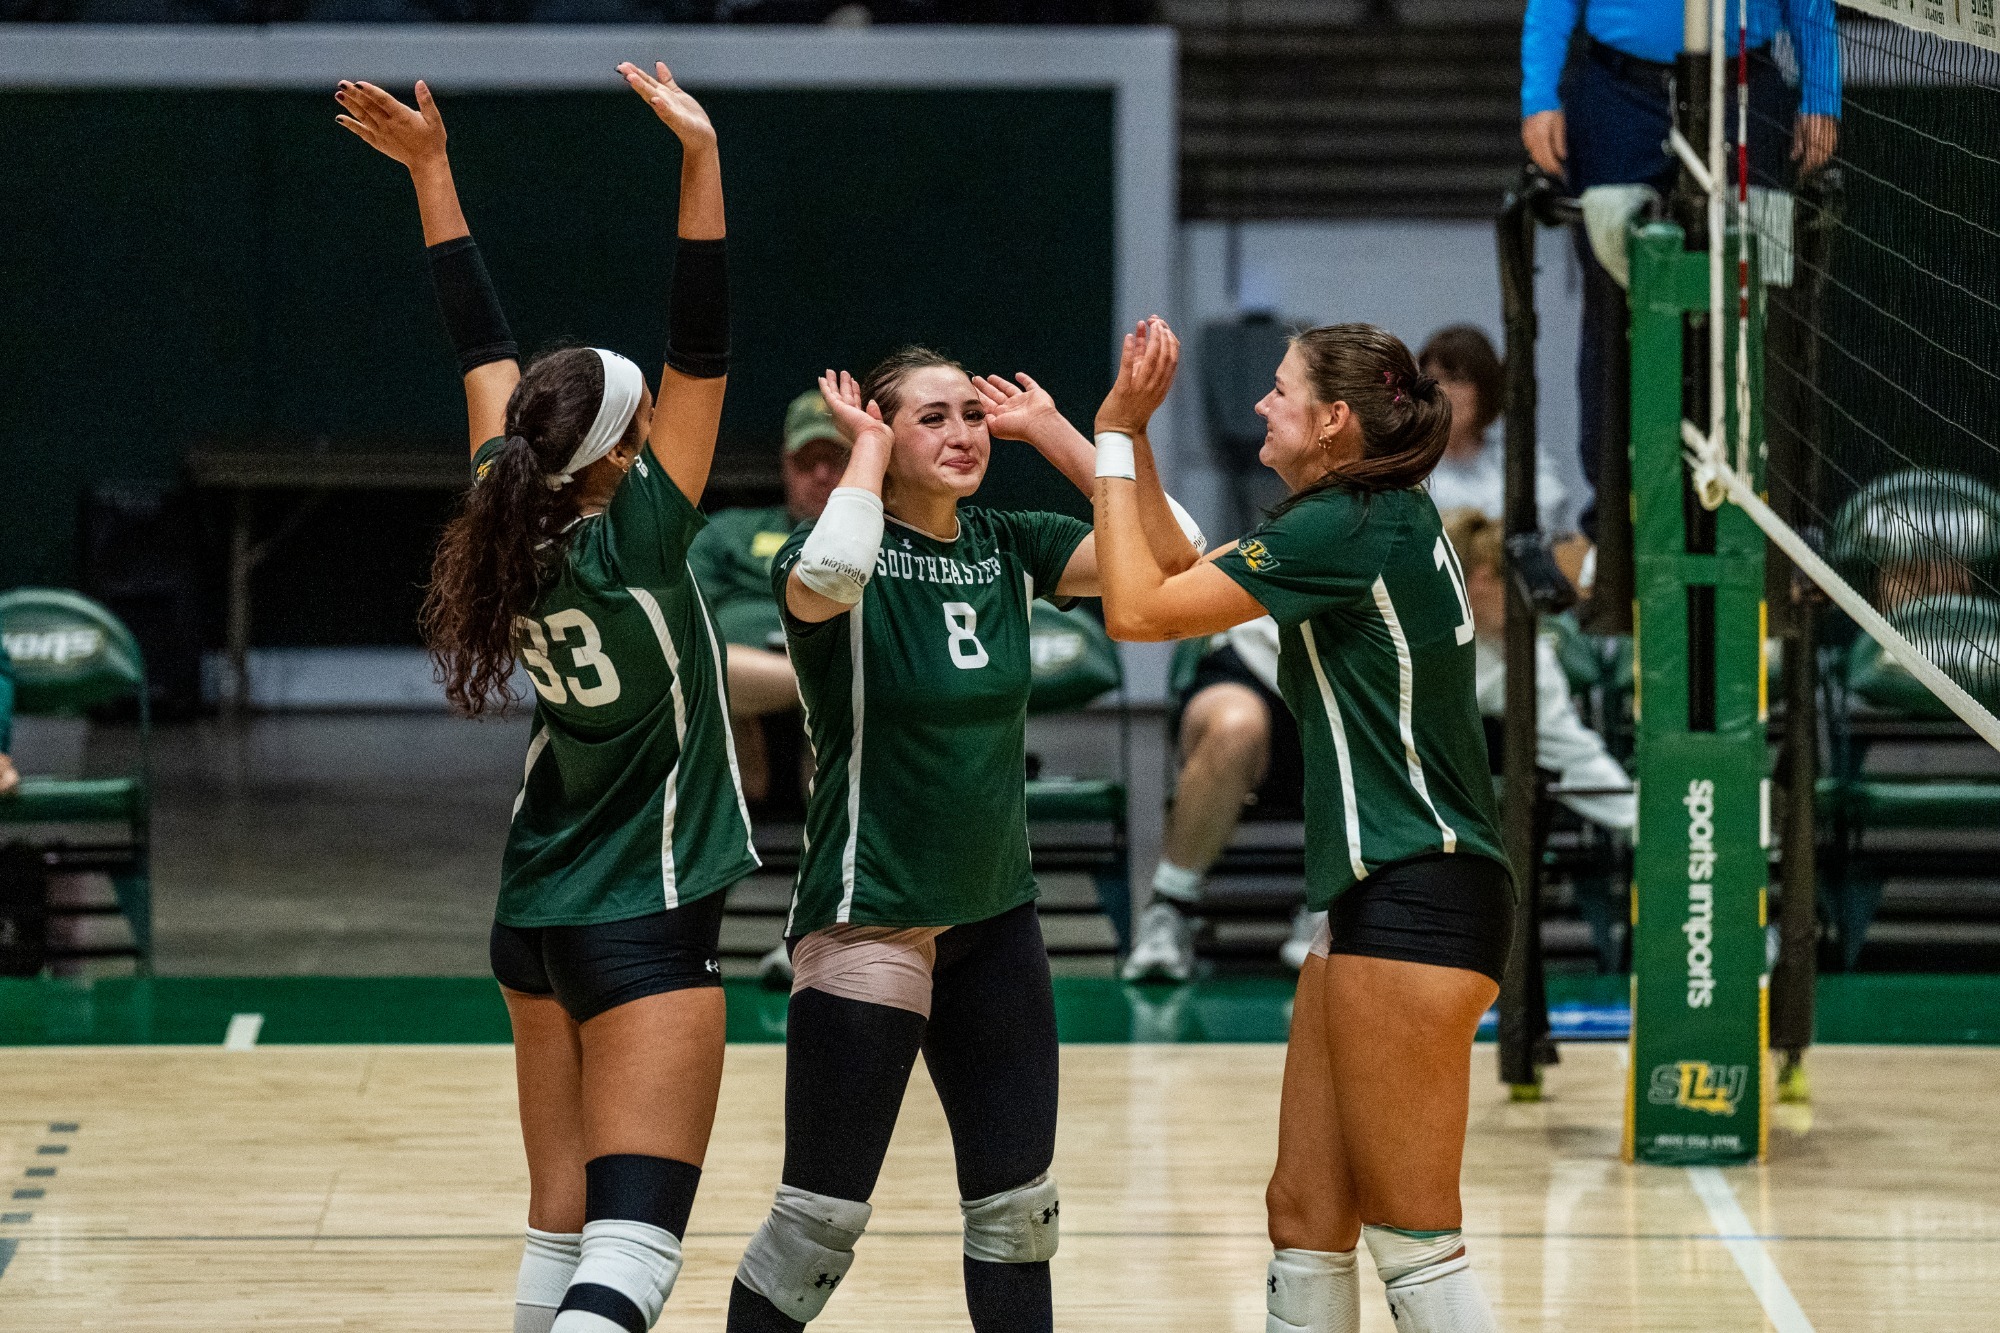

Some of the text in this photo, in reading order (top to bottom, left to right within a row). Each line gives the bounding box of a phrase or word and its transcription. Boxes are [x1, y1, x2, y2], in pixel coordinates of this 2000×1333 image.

[511, 608, 621, 708] 33
[942, 602, 989, 670] 8
[1682, 779, 1718, 1009] sports imports
[1647, 1060, 1750, 1118] SLU
